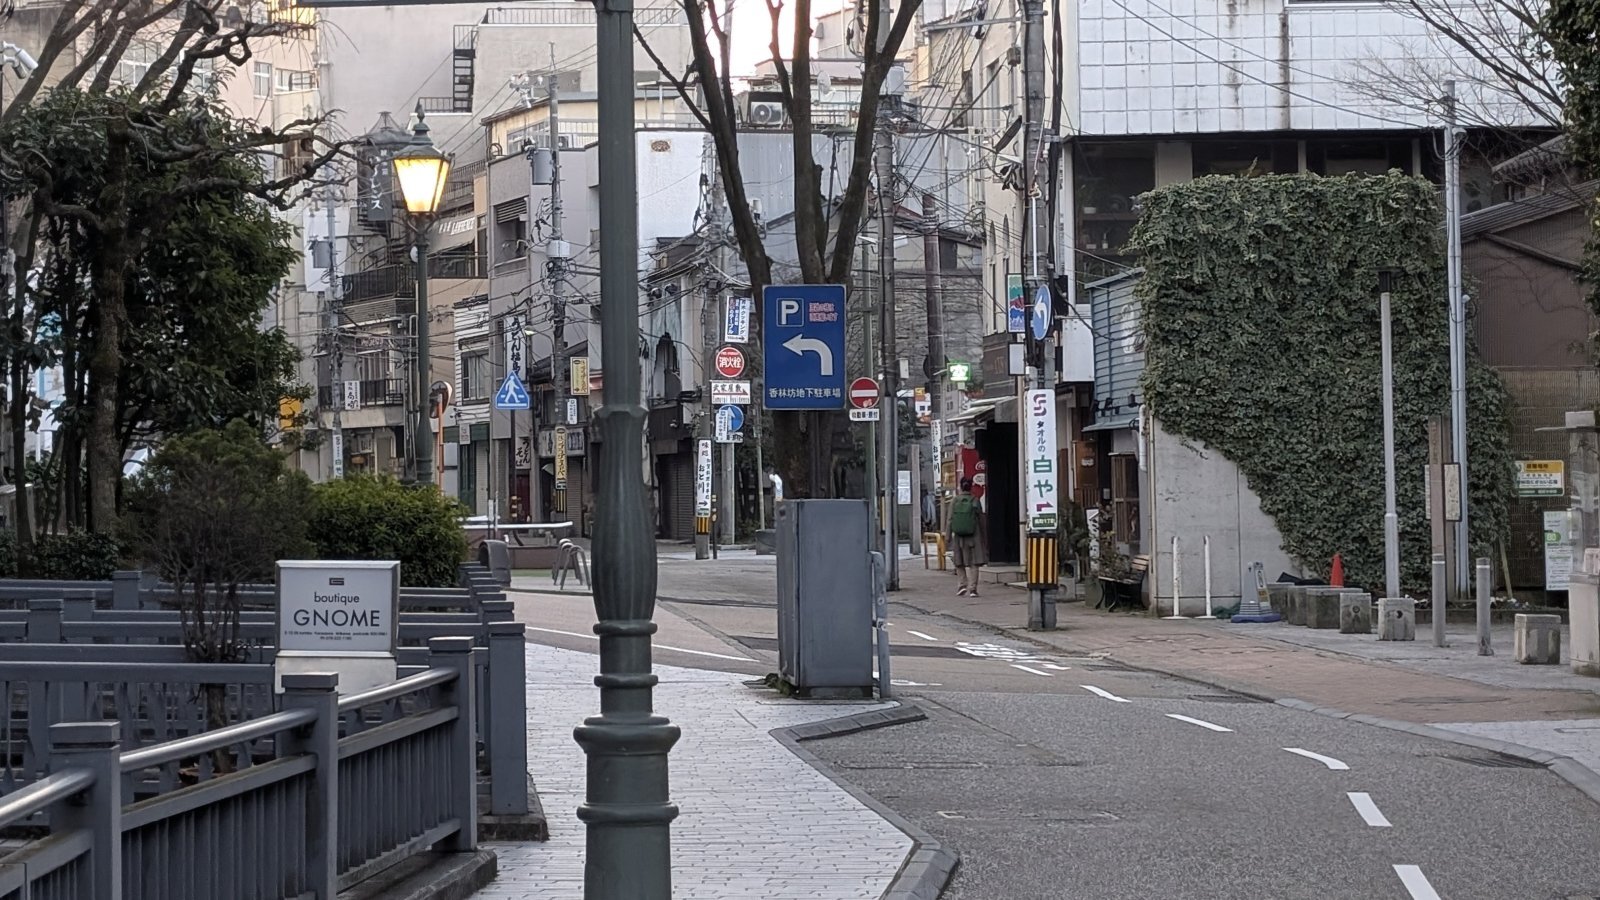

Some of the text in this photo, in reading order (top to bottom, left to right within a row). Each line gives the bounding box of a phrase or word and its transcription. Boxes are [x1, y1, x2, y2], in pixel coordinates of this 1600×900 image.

[780, 300, 800, 325] P
[719, 356, 742, 368] 消火栓
[713, 383, 742, 393] 武家屋敷
[769, 387, 841, 398] 香林坊地下駐車場
[314, 591, 360, 606] boutique
[293, 609, 381, 627] GNOME
